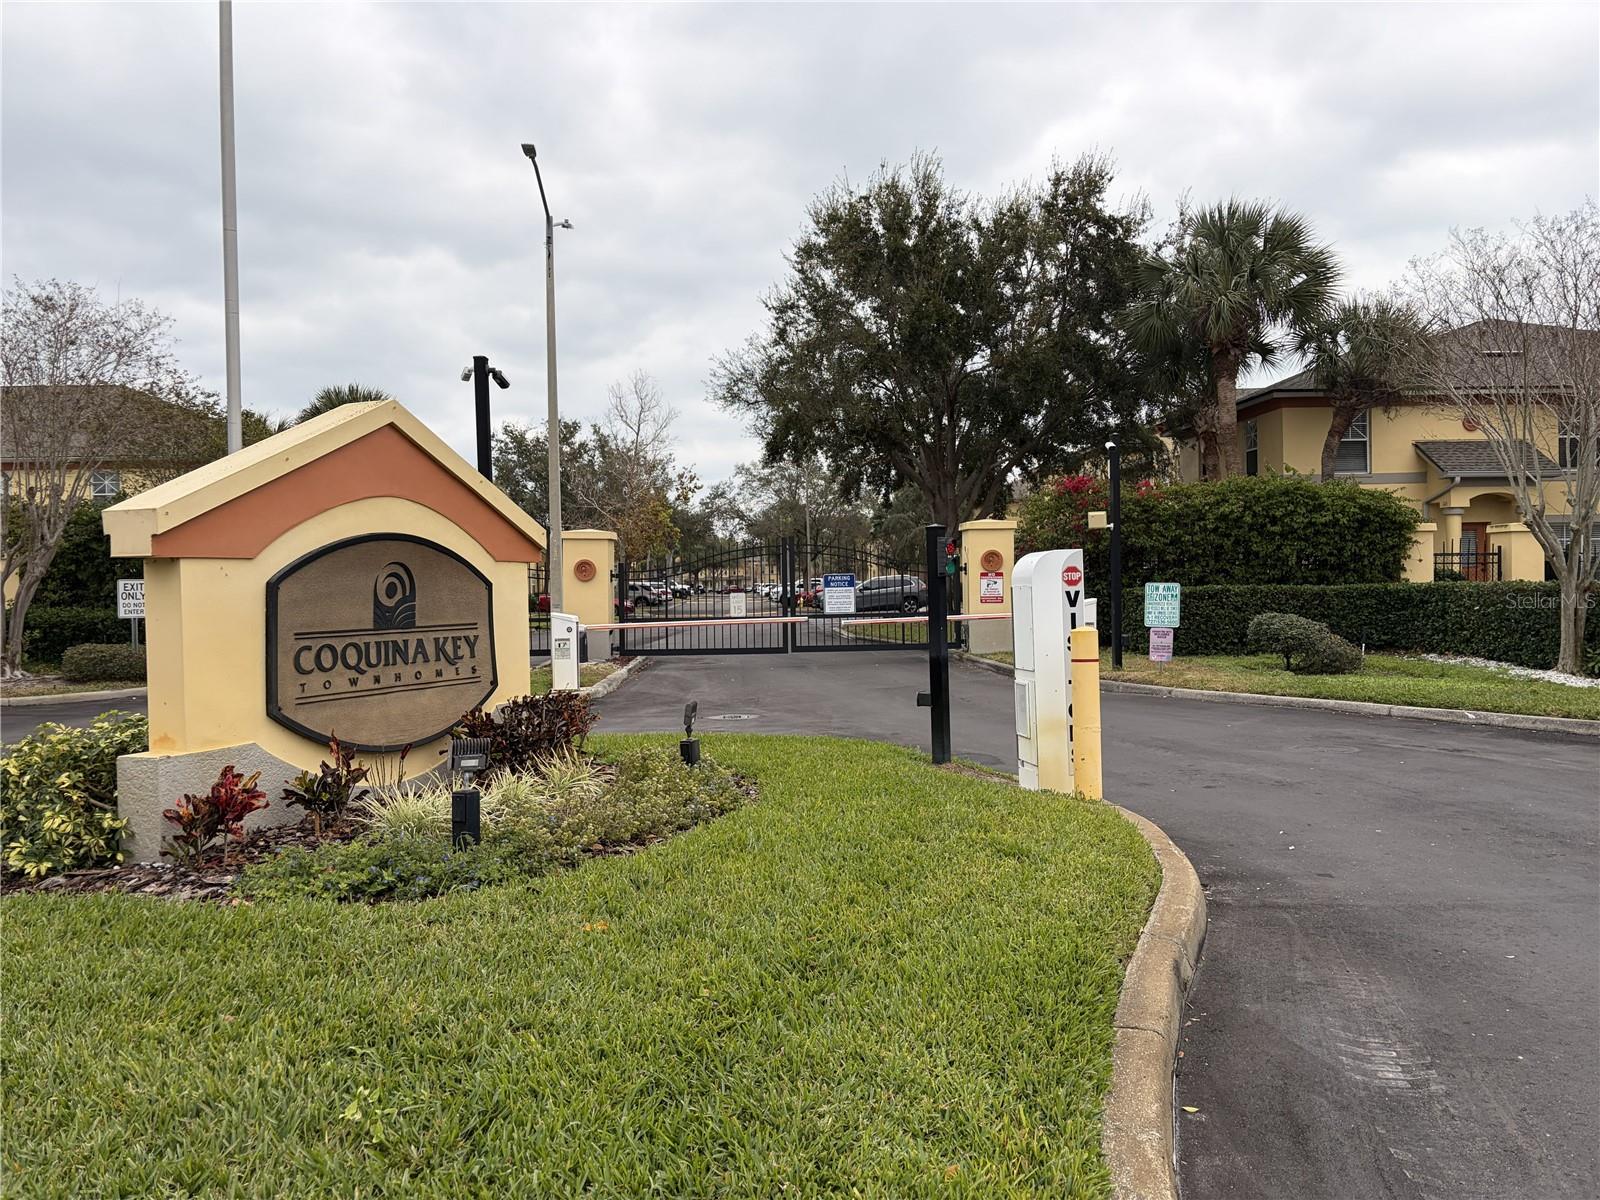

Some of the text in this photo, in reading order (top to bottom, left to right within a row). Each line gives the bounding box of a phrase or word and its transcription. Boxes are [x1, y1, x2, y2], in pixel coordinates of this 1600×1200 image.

[1063, 572, 1081, 581] STOP
[123, 583, 145, 591] EXIT
[121, 592, 145, 600] ONLY
[1154, 594, 1170, 602] ZONE
[733, 605, 744, 615] 15
[294, 635, 480, 675] COQUINA KEY
[300, 665, 478, 694] TOWNHOMES
